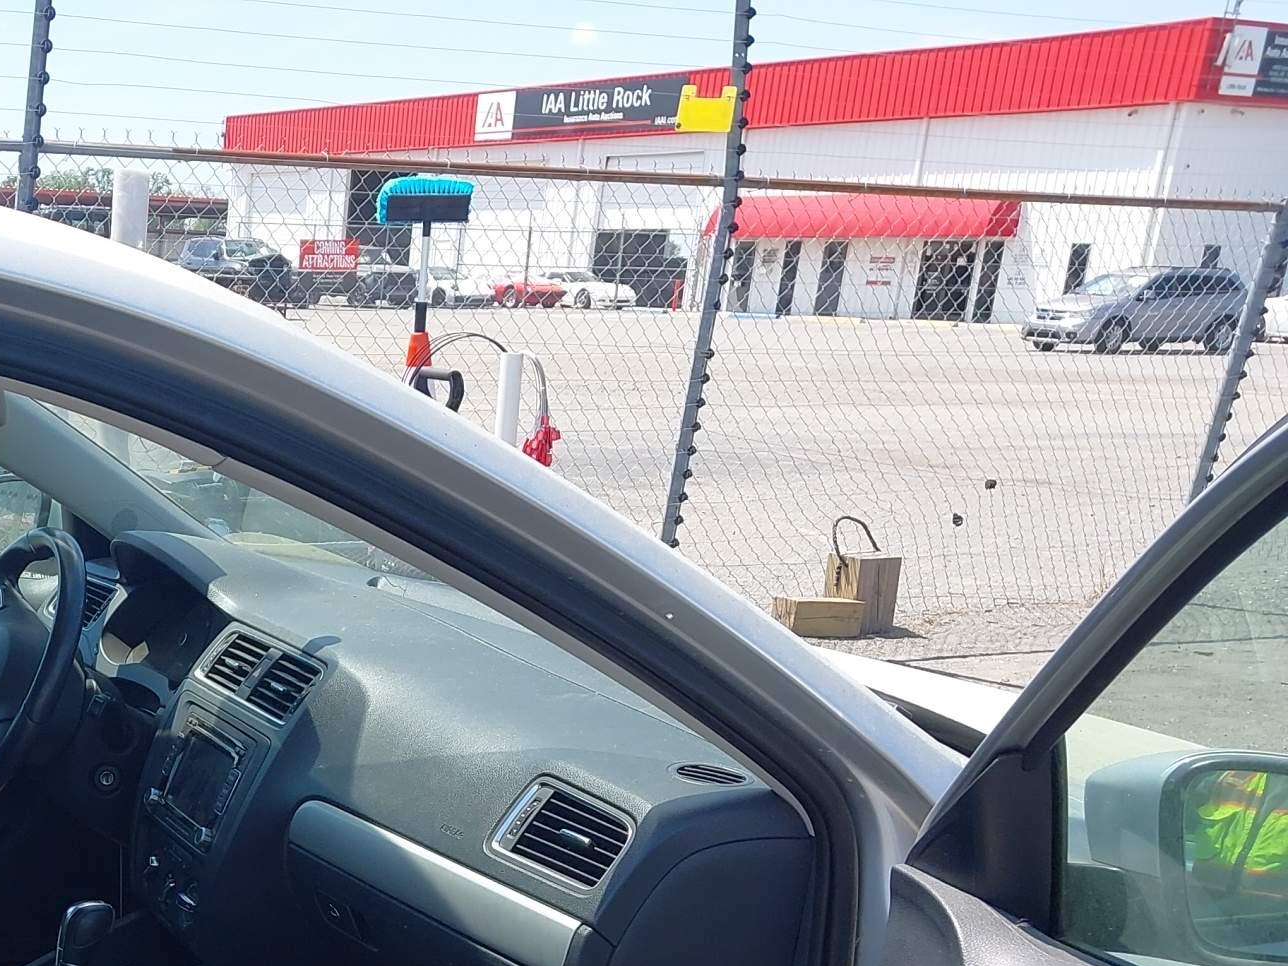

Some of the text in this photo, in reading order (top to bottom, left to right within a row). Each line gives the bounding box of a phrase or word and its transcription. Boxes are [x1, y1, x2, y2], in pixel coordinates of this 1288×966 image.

[541, 84, 652, 114] IAA Little Rock
[302, 254, 356, 268] ATTRACTIONS
